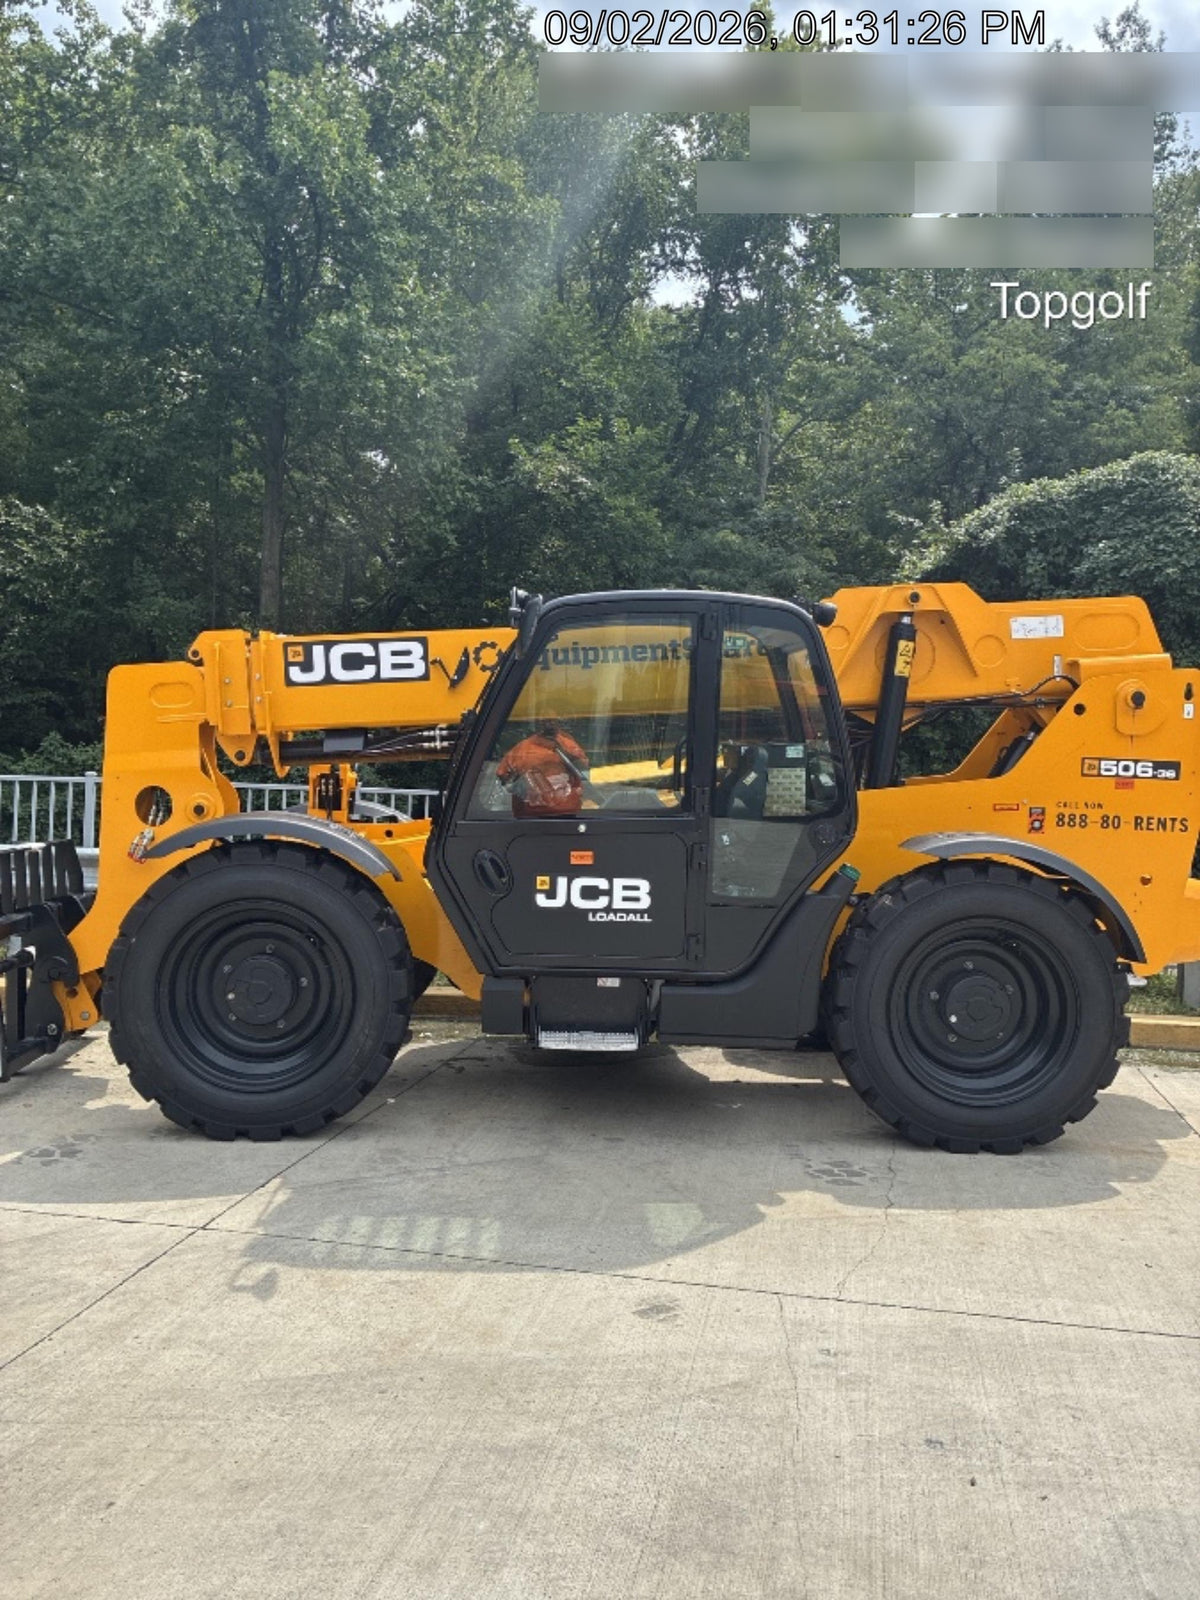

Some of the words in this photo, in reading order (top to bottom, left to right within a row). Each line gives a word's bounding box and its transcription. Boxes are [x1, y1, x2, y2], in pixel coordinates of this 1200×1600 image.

[288, 640, 426, 684] JCB
[535, 875, 652, 910] JCB
[588, 911, 653, 922] LOADALL
